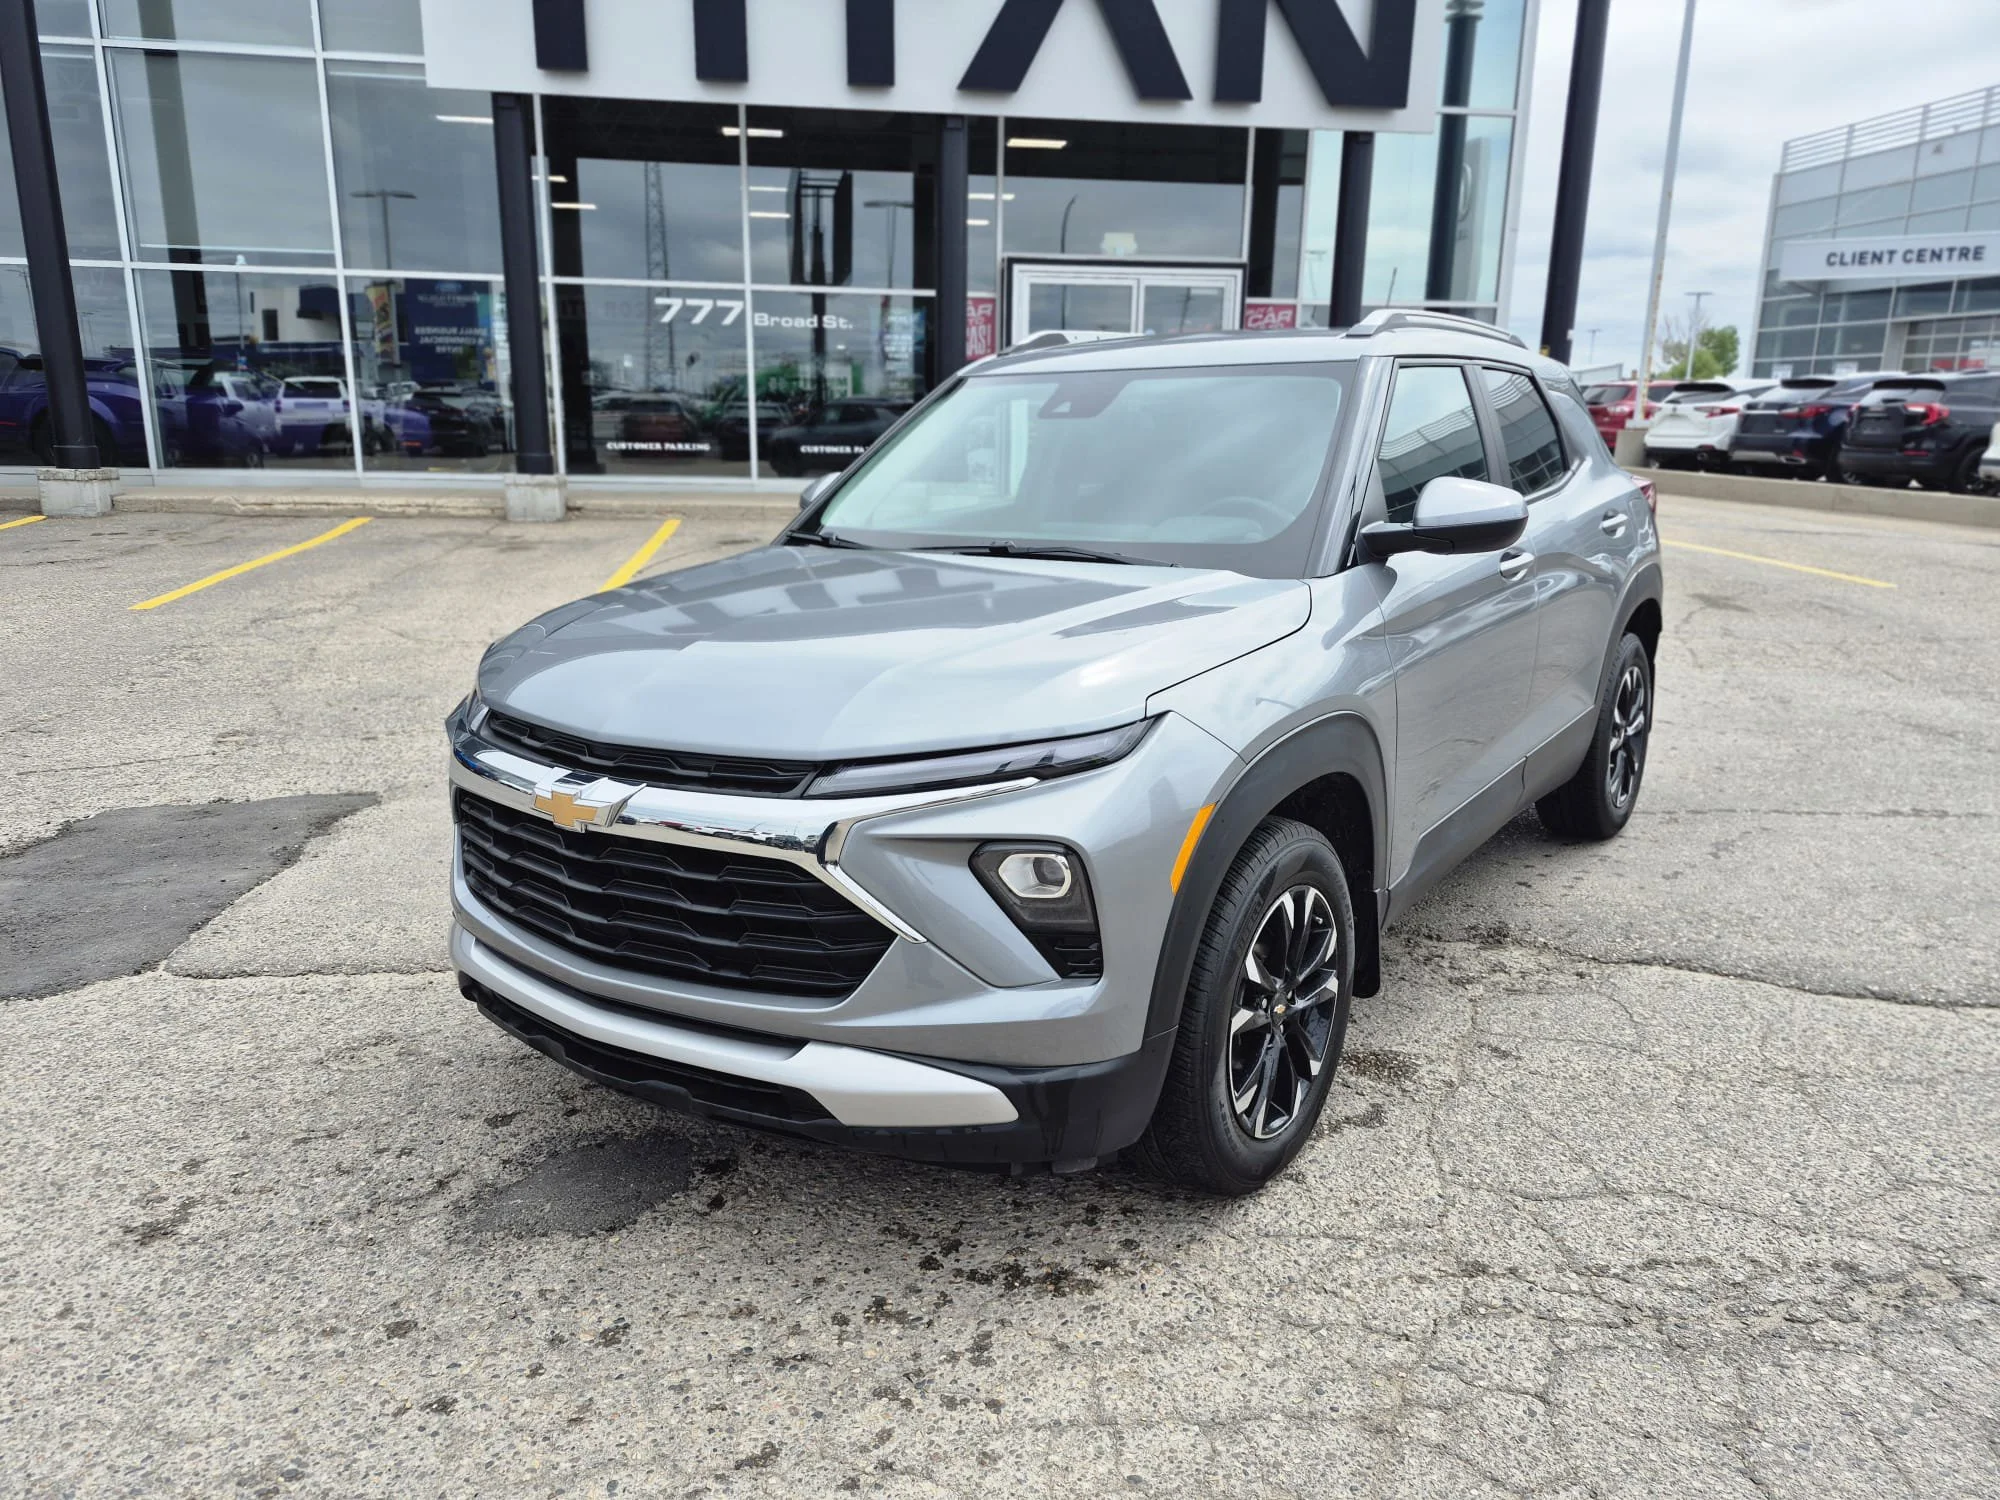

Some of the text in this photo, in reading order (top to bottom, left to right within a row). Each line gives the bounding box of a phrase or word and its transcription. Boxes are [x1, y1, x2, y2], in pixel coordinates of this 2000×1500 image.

[1825, 245, 1987, 267] CLIENT CENTRE
[654, 297, 745, 325] 777
[754, 312, 818, 328] Broad
[822, 315, 853, 329] St.
[966, 303, 993, 318] AR
[606, 441, 711, 452] CUSTOMER PARKING
[800, 445, 852, 453] CUSTOMER
